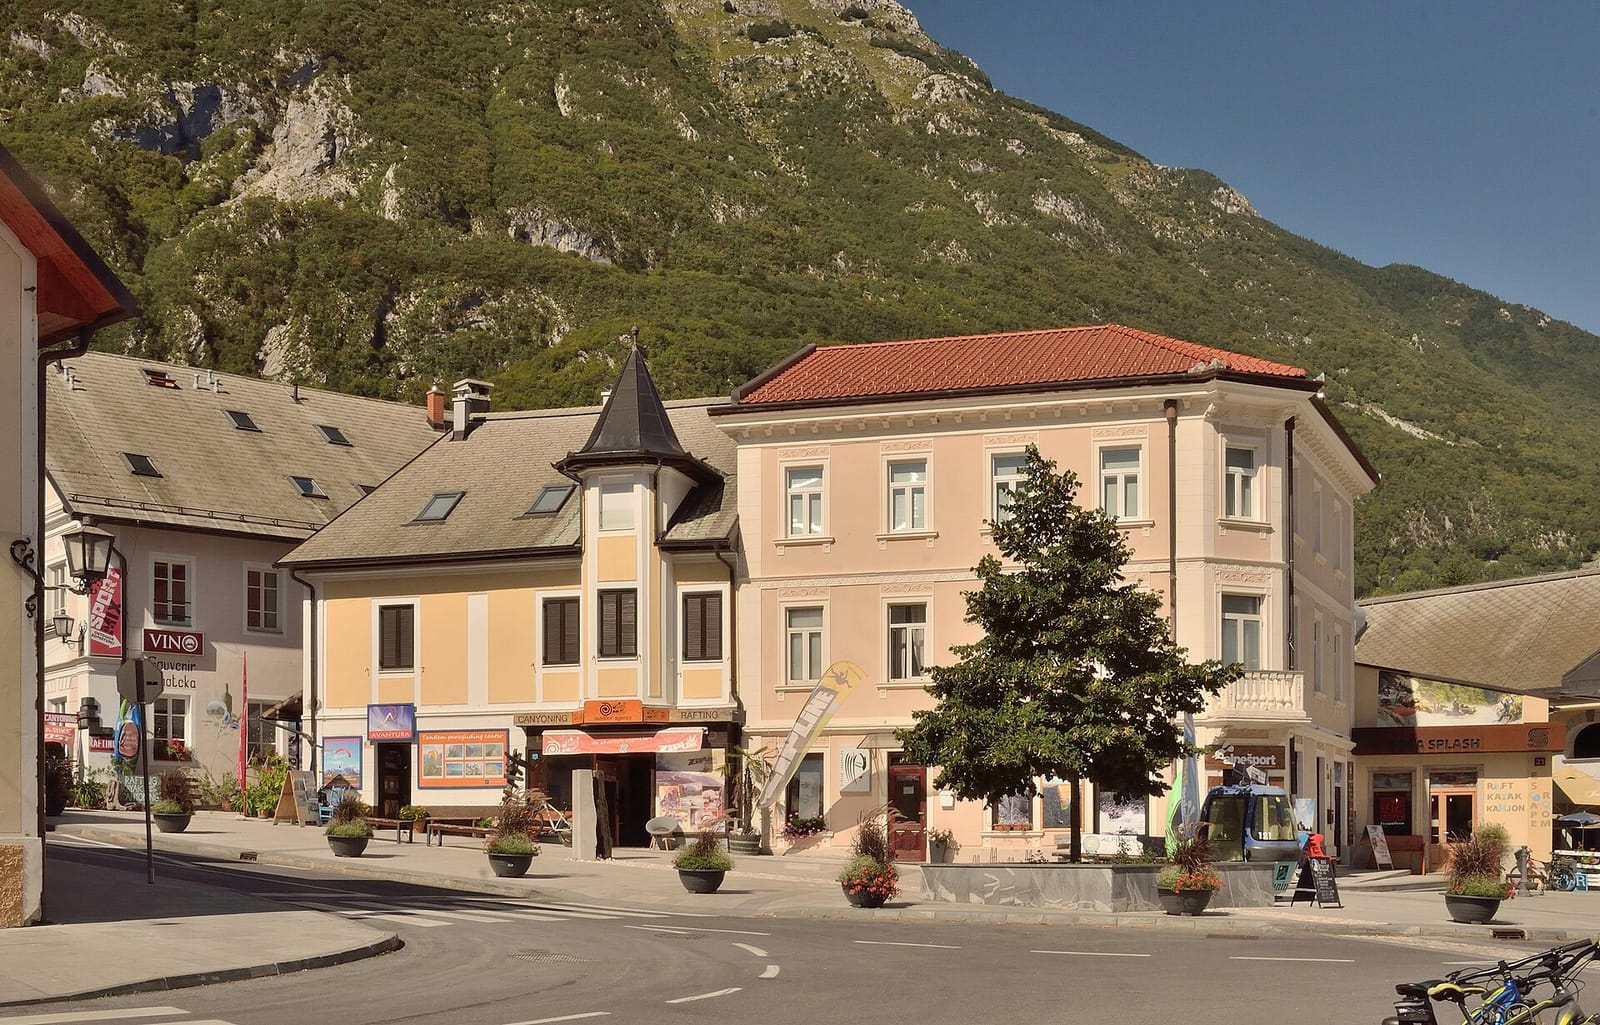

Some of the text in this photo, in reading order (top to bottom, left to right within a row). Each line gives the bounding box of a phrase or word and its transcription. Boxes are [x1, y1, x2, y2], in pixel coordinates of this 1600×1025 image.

[149, 633, 198, 652] VINO
[517, 714, 568, 725] CANYONING
[680, 708, 719, 720] RAFTING
[371, 731, 411, 739] AVANTURA
[89, 737, 115, 749] RAFTIN
[1428, 738, 1481, 750] SPLASH
[1530, 772, 1541, 828] ESAPE
